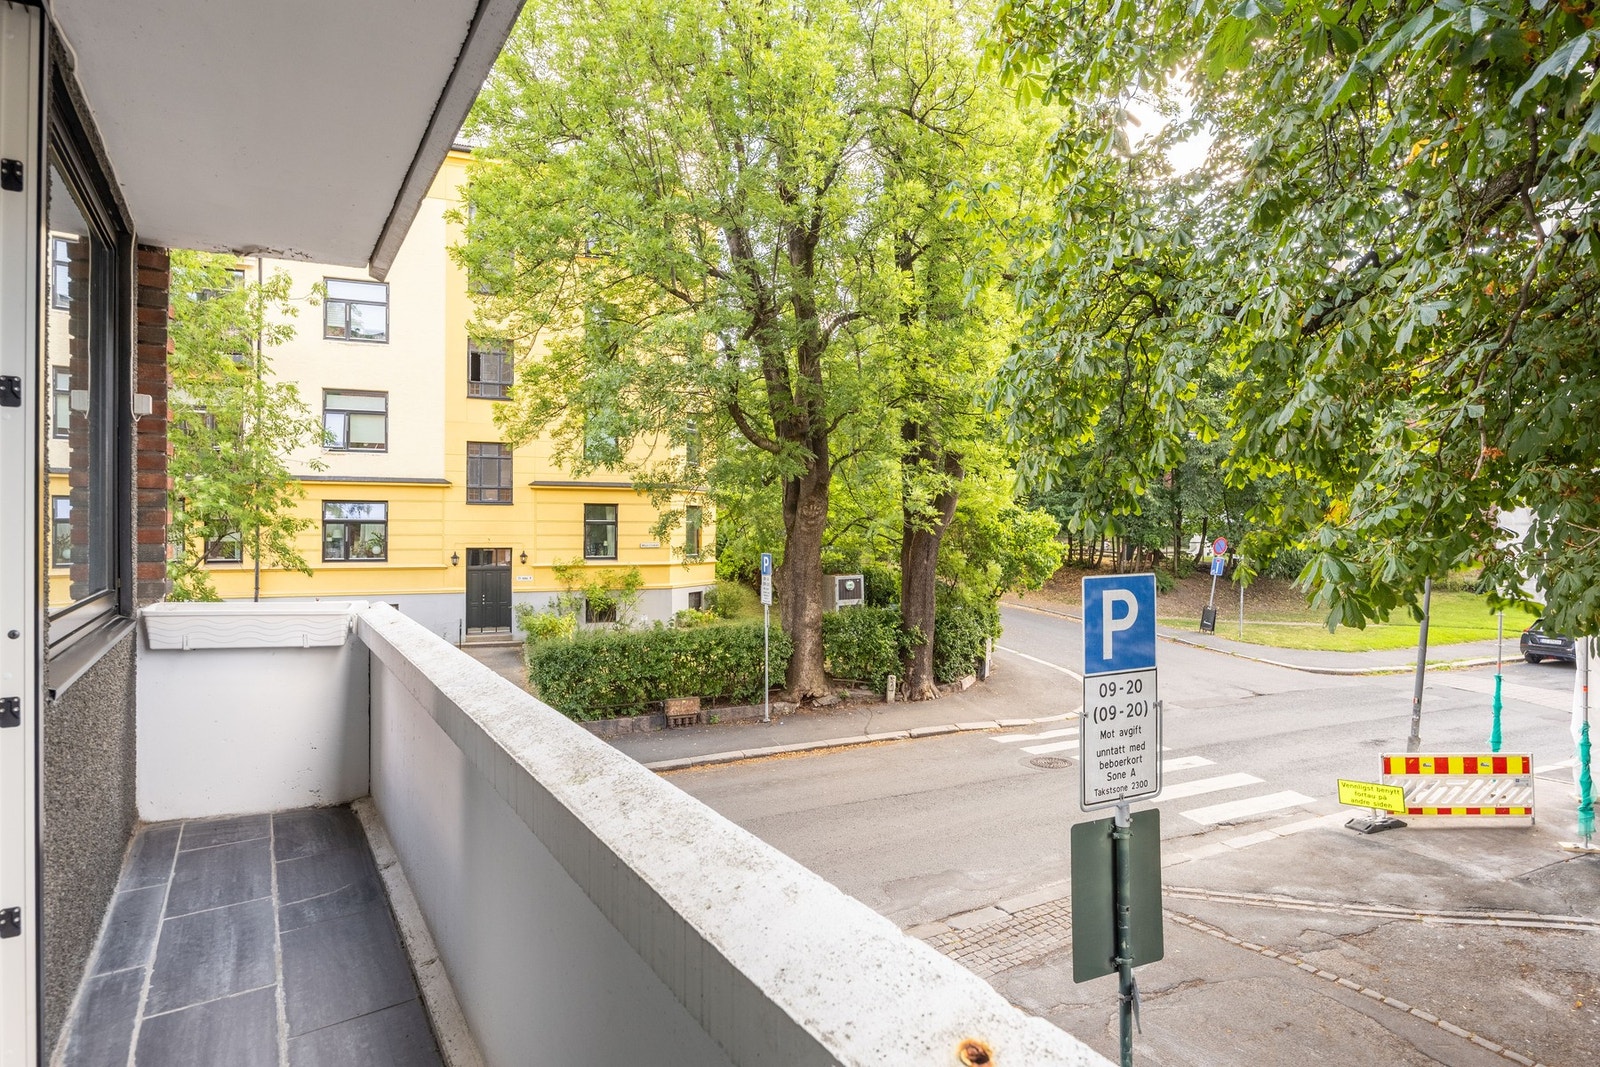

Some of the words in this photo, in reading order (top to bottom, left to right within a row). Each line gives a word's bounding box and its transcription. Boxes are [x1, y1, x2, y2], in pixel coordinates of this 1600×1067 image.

[764, 556, 769, 572] P
[1102, 588, 1139, 660] P
[1099, 678, 1143, 698] 09-20
[1093, 700, 1148, 724] (09-20)
[1100, 729, 1115, 739] Mot
[1119, 724, 1142, 738] avgift
[1096, 745, 1125, 758] unntatt
[1129, 741, 1146, 752] med
[1099, 754, 1143, 770] beboerkort
[1106, 771, 1127, 782] Sone
[1130, 768, 1136, 777] A
[1094, 785, 1128, 796] Takstsone
[1131, 779, 1149, 790] 2300
[1341, 782, 1374, 791] Vennligst
[1376, 787, 1400, 795] benytt
[1354, 791, 1376, 799] fortau
